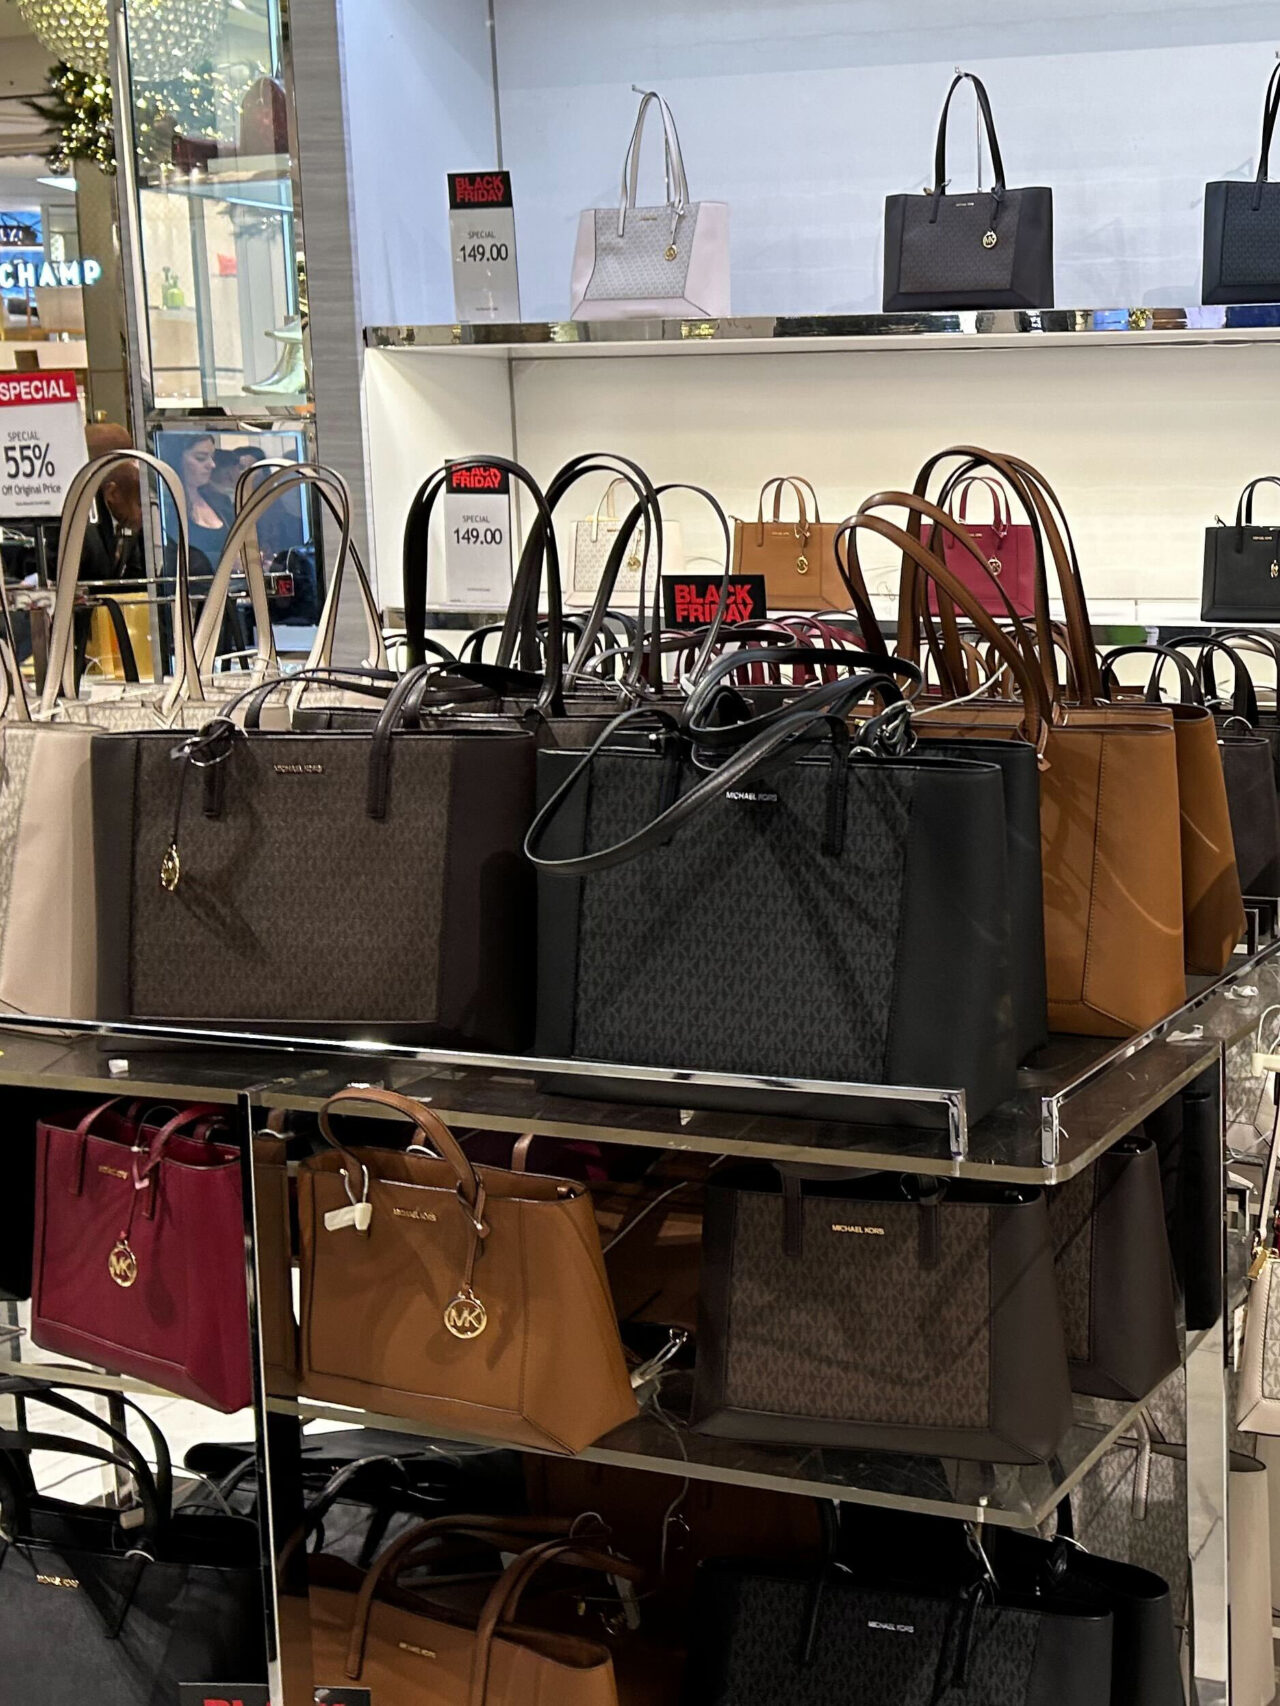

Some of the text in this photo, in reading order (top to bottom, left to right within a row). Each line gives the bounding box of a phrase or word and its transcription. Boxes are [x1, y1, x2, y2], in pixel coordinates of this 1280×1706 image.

[455, 175, 503, 191] BLACK
[456, 189, 504, 203] FRIDAY
[467, 230, 496, 240] SPECIAL
[460, 243, 509, 262] 149.00
[0, 259, 102, 289] CHAMP
[0, 379, 71, 401] SPECIAL
[7, 430, 40, 442] SPECIAL
[4, 442, 56, 479] 55%
[2, 482, 62, 498] Off Original Price
[452, 475, 502, 489] FRIDAY
[461, 514, 491, 523] SPECIAL
[453, 527, 503, 545] 149.00
[674, 584, 753, 604] BLACK
[725, 791, 757, 801] MICHAEL
[831, 1223, 885, 1235] MICHAEL KORS
